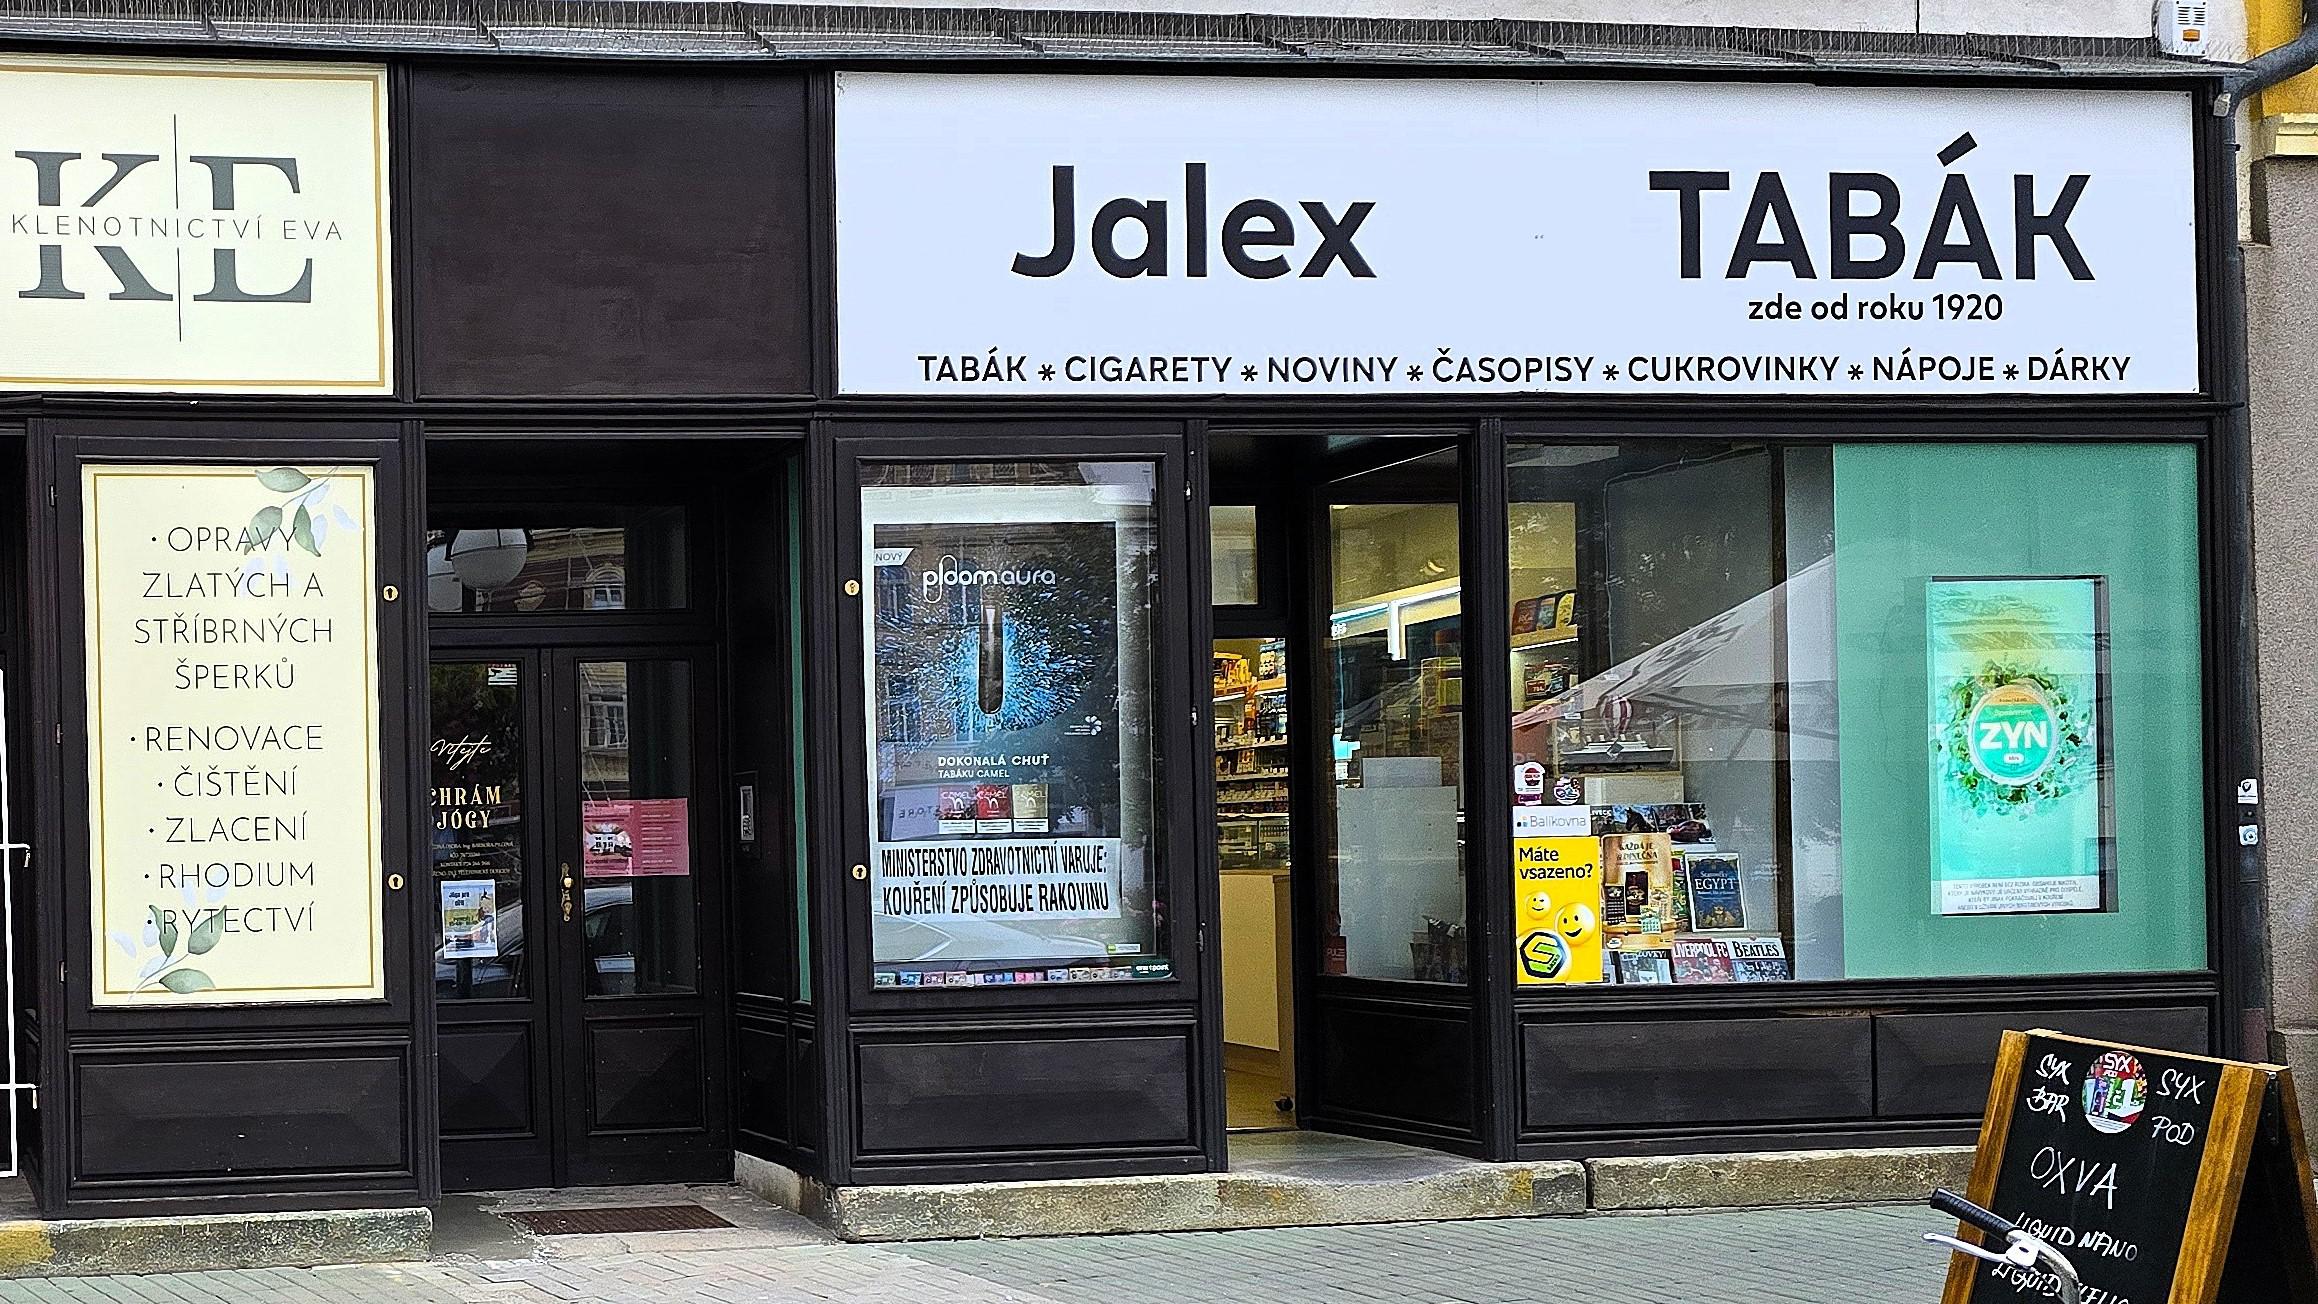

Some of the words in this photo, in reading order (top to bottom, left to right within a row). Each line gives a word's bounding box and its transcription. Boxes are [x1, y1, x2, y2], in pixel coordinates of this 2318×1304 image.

[1010, 162, 1377, 279] Jalex
[1649, 131, 2095, 280] TABÁK
[12, 213, 262, 240] KLENOTNICTVÍ
[284, 220, 342, 241] EVA
[1748, 293, 1802, 320] zde
[1810, 293, 1848, 320] od
[1857, 293, 1924, 320] roku
[1932, 293, 2002, 320] 1920
[917, 346, 1027, 382] TABÁK
[1064, 356, 1232, 383] CIGARETY
[1267, 356, 1398, 382] NOVINY
[1431, 348, 1594, 382] ČASOPISY
[1627, 356, 1839, 382] CUKROVINKY
[1872, 347, 1995, 381] NÁPOJE
[2027, 347, 2131, 381] DÁRKY
[168, 526, 297, 552] OPRAVY
[875, 551, 903, 562] NOVÝ
[142, 567, 289, 598] ZLATÝCH
[303, 572, 324, 597] A
[134, 612, 333, 643] STŘÍBRNÝCH
[175, 657, 295, 690] ŠPERKŮ
[146, 725, 324, 751] RENOVACE
[1980, 720, 2048, 750] ZYN
[938, 754, 1006, 767] DOKONALÁ
[1011, 753, 1050, 767] CHUŤ
[938, 769, 974, 779] TABÁKU
[976, 769, 1010, 779] CAMEL
[174, 765, 298, 797] ČIŠTĚNÍ
[166, 810, 308, 843] ZLACENÍ
[436, 808, 491, 829] JÓGY
[882, 847, 967, 878] MINISTERSTVO
[971, 841, 1058, 876] ZDRAVOTNICTVÍ
[1060, 845, 1108, 874] VARUJE:
[1518, 846, 1559, 862] Máte
[160, 862, 315, 889] RHODIUM
[1518, 863, 1593, 880] vsazeno?
[1694, 878, 1736, 890] EGYPT
[882, 880, 947, 915] KOUŘENÍ
[951, 879, 1034, 914] ZPŮSOBUJE
[1038, 882, 1109, 911] RAKOVINU
[163, 901, 314, 934] RYTECTVÍ
[1715, 942, 1729, 958] FC
[1731, 941, 1780, 958] BEATLES
[2036, 1053, 2072, 1086] SYX
[2103, 1052, 2133, 1074] SYX
[2156, 1068, 2206, 1105] SYX
[2026, 1085, 2071, 1123] BAR
[2151, 1115, 2195, 1146] POD
[2030, 1146, 2118, 1210] OXVA
[2013, 1211, 2076, 1247] LIQUID
[2077, 1230, 2139, 1262] NANO
